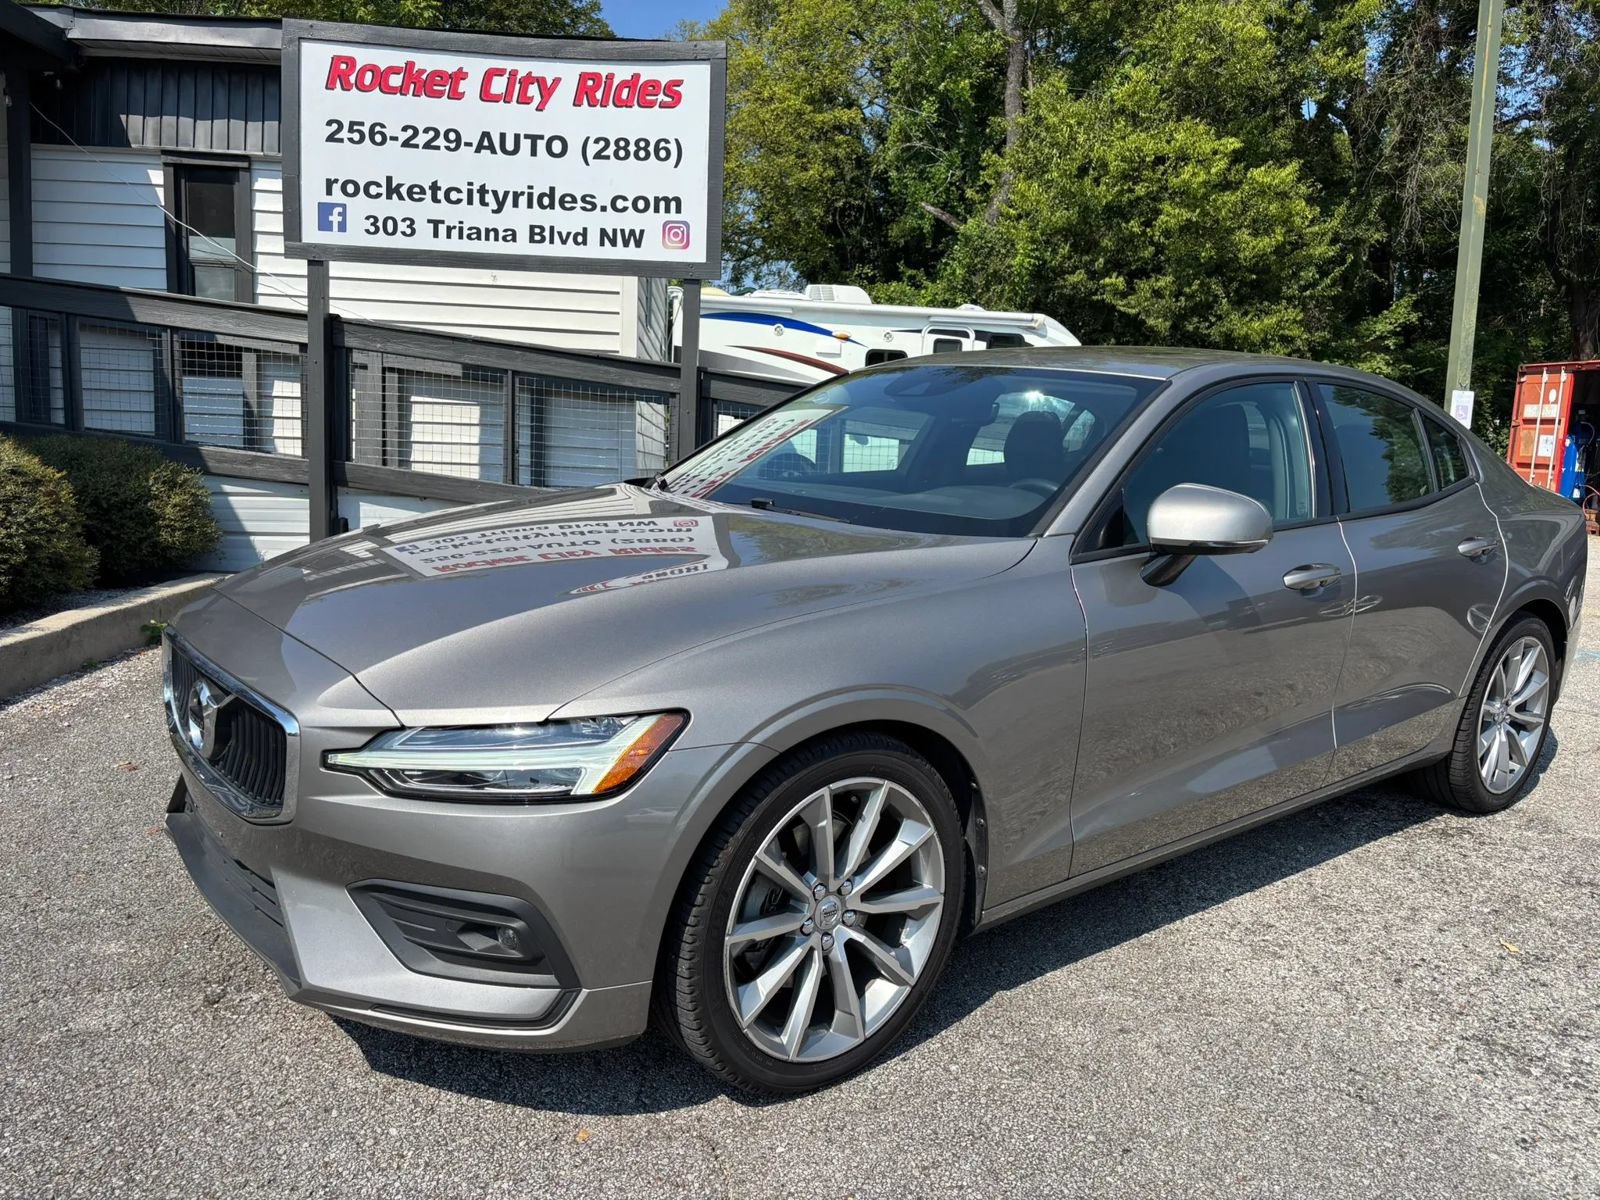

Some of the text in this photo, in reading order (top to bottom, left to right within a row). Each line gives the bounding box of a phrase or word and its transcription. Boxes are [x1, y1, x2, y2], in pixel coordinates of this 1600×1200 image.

[325, 54, 685, 111] Rocket City Rides
[324, 118, 684, 168] 256-229-AUTO (2886)
[325, 176, 683, 215] rocketcityrides.com
[364, 215, 646, 249] 303 Triana Blvd NW
